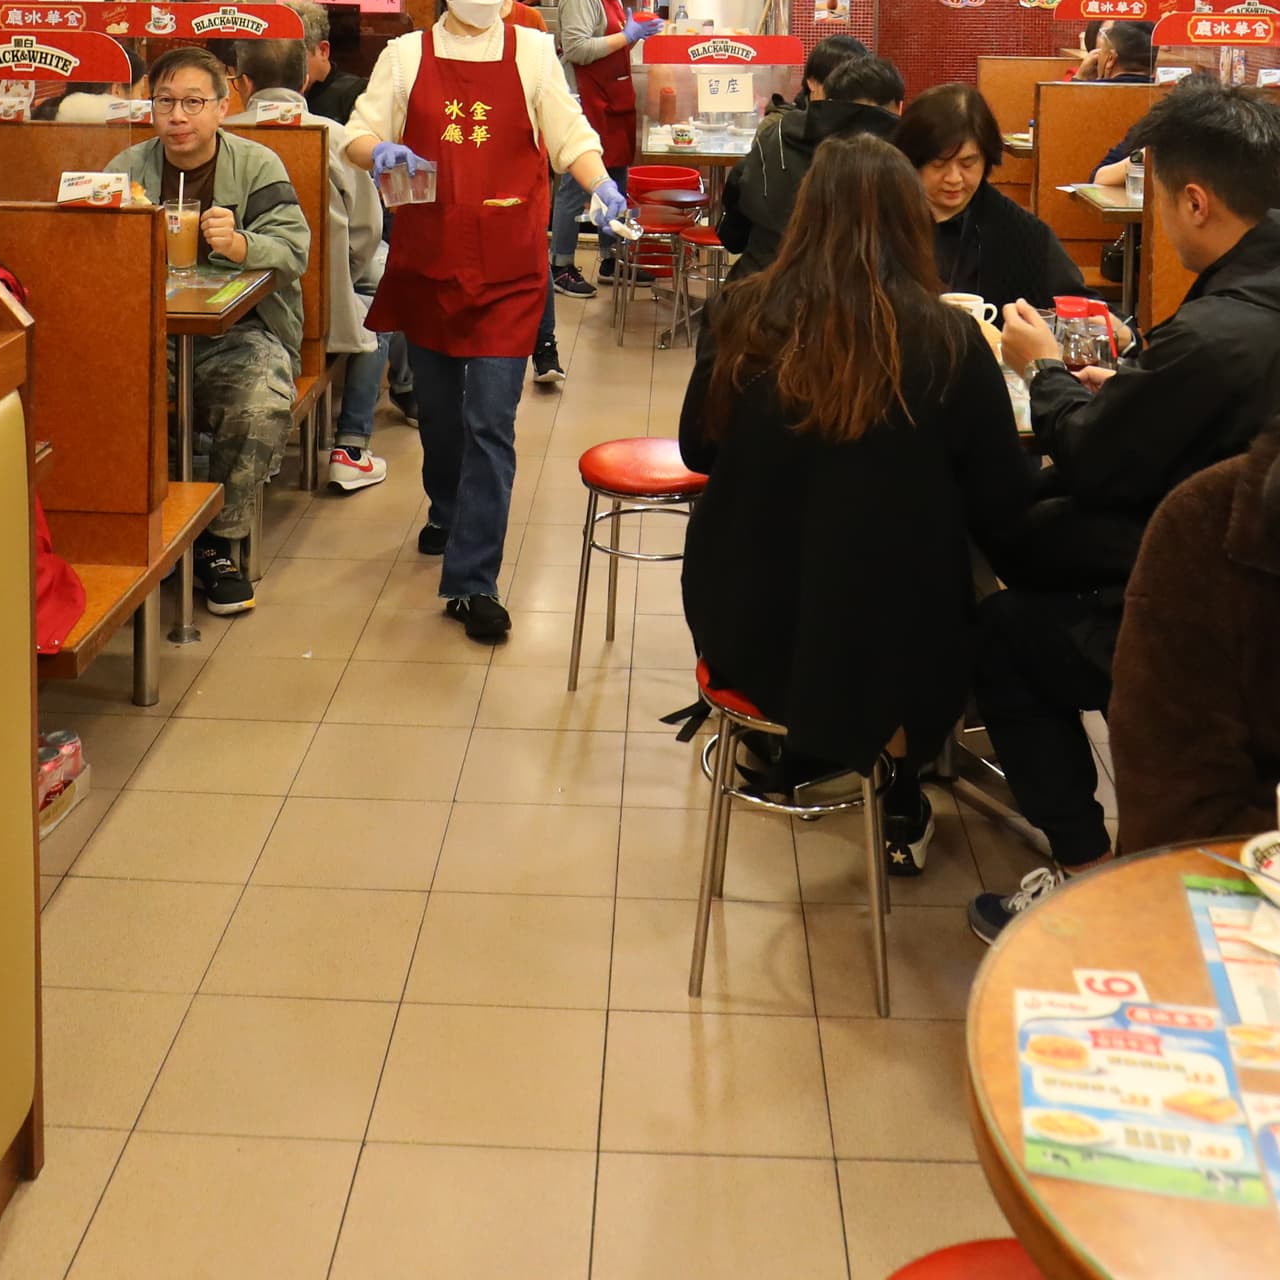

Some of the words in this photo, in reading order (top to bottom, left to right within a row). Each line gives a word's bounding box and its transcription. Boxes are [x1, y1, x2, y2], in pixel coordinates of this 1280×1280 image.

[5, 7, 82, 26] 金華冰廳
[1086, 0, 1145, 15] 金華冰廳
[194, 16, 264, 34] BLACK&WHITE
[1193, 20, 1271, 39] 金華冰廳
[690, 44, 752, 59] BLACK&WHITE
[708, 77, 741, 95] 留座
